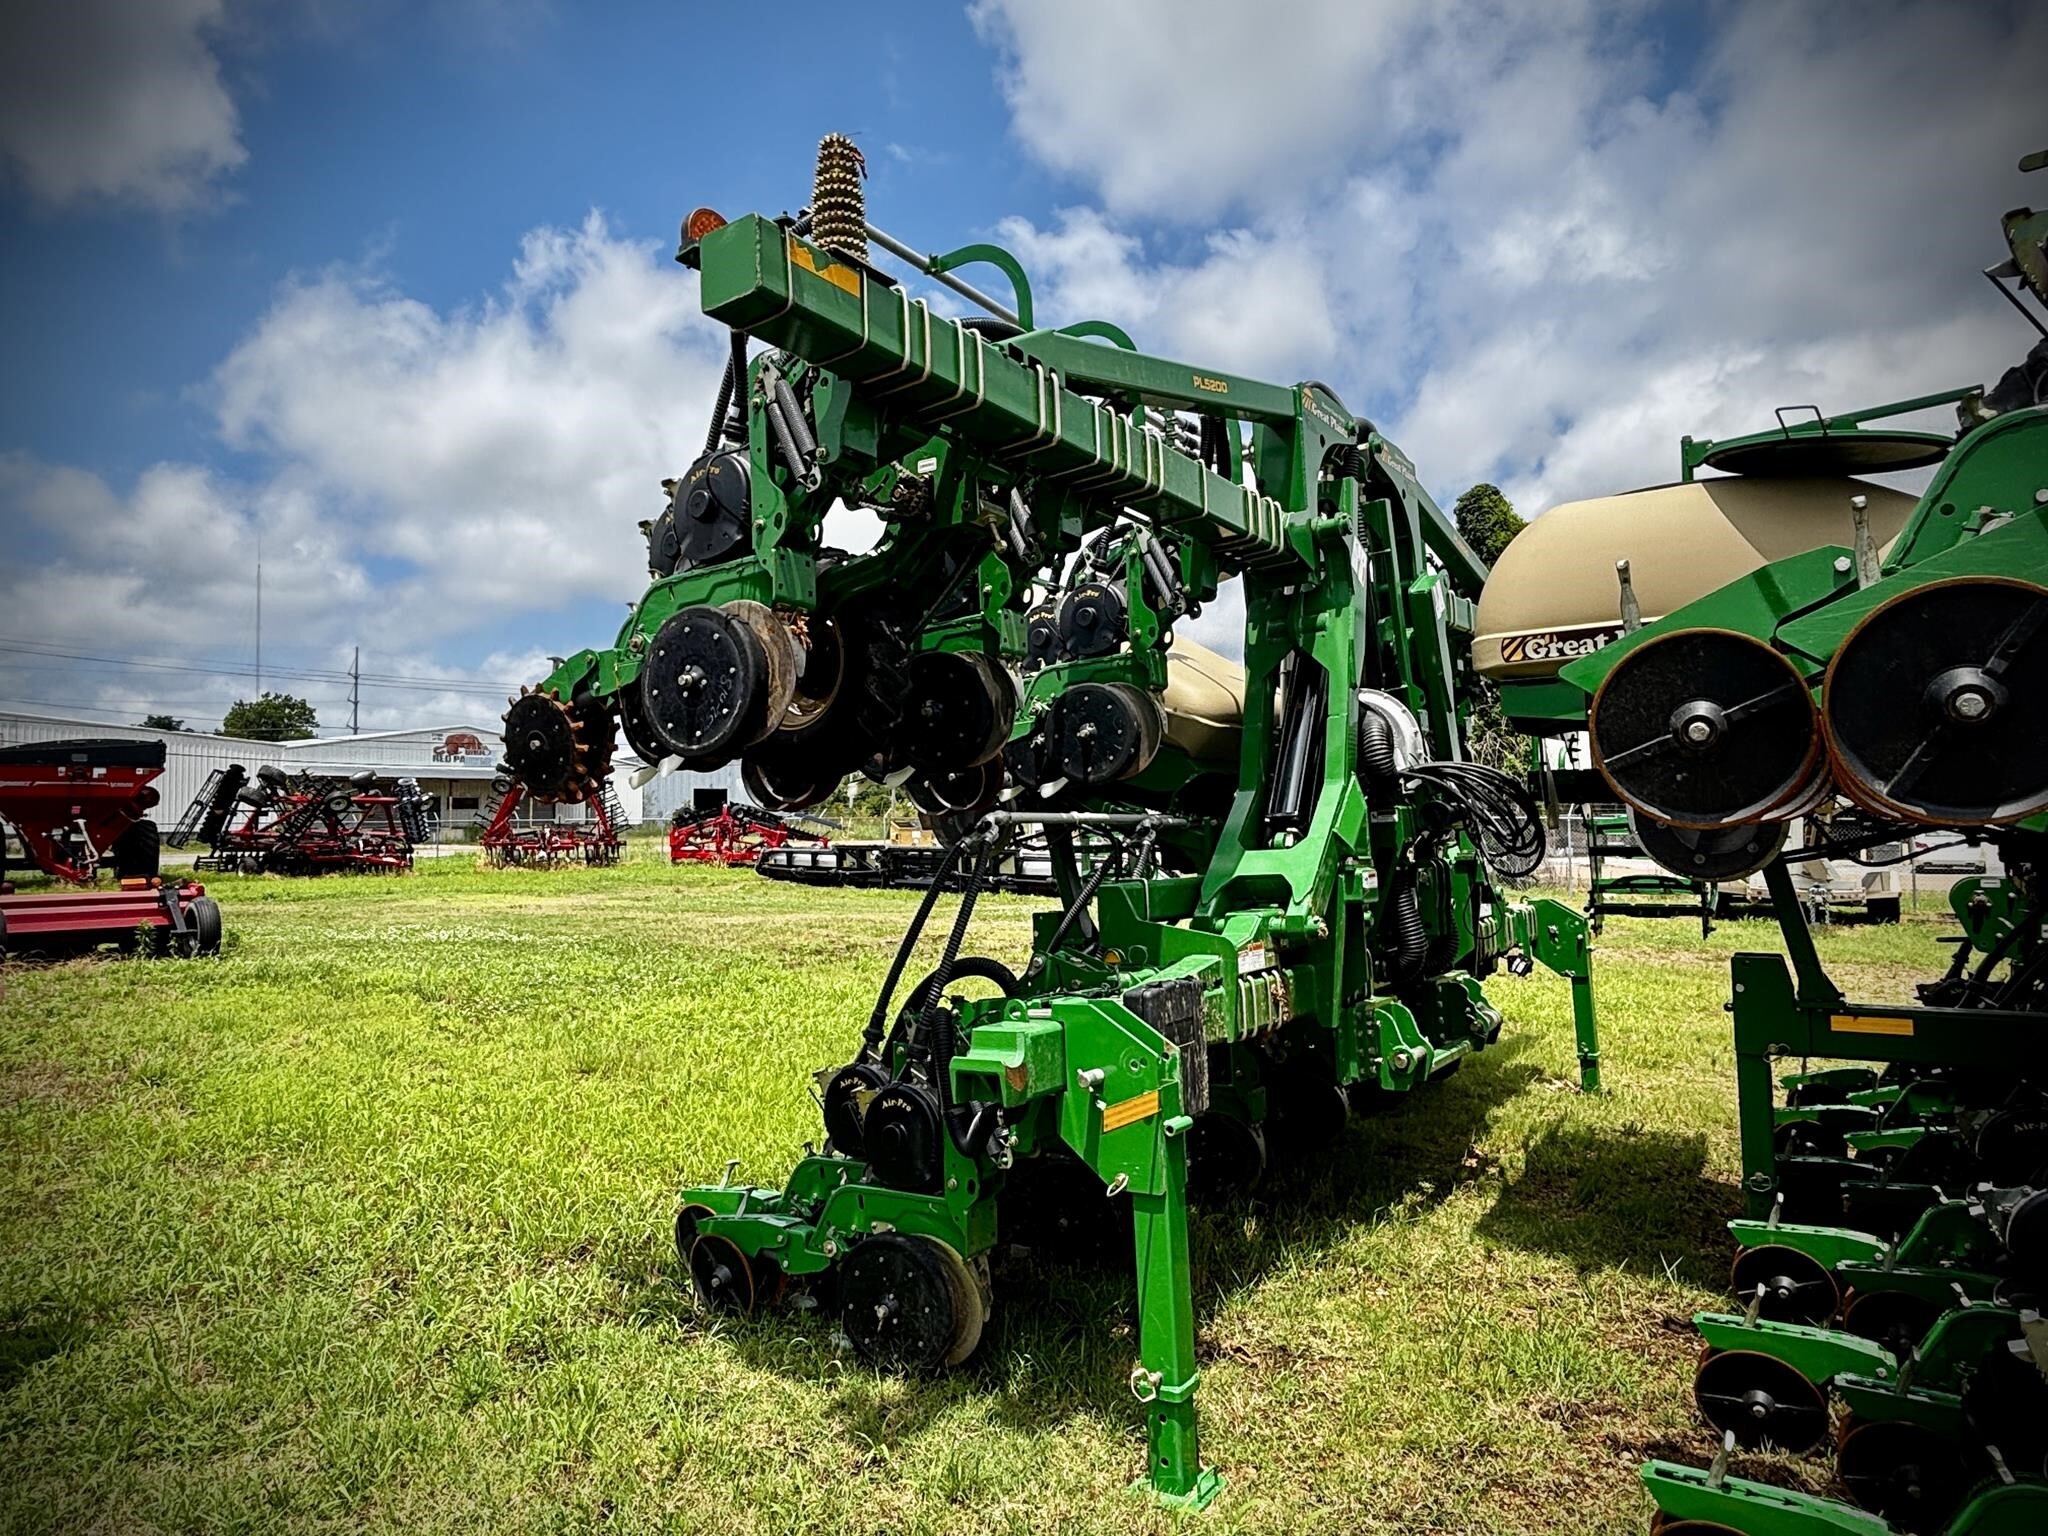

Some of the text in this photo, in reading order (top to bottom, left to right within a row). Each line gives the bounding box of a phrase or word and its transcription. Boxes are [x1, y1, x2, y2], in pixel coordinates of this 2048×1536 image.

[1193, 376, 1228, 393] PL5200
[1311, 403, 1330, 425] Great
[689, 466, 722, 485] Air-ro
[1525, 633, 1609, 659] Great
[881, 1098, 912, 1112] Air-Pro
